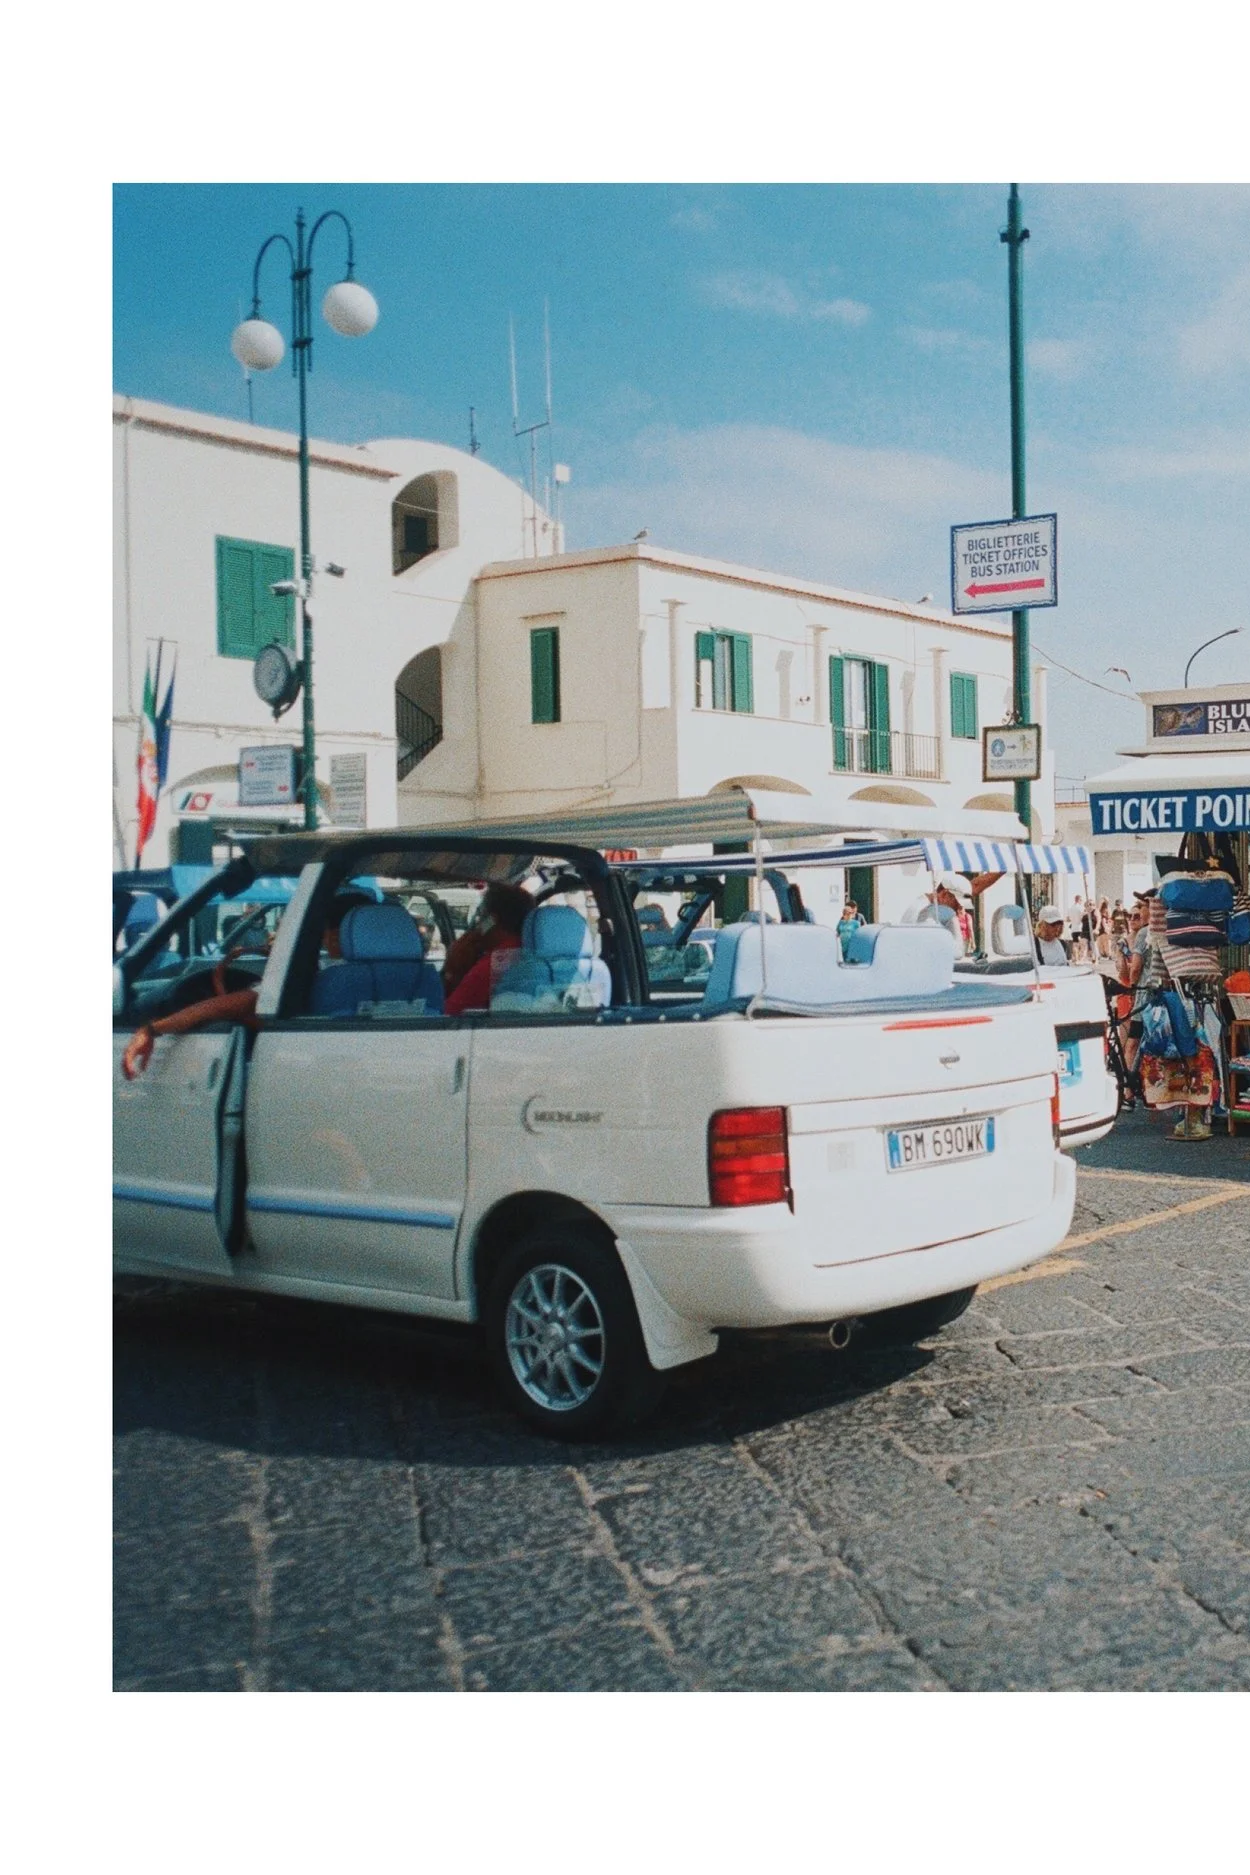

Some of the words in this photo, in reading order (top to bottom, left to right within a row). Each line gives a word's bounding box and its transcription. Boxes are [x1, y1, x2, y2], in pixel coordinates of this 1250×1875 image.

[967, 531, 1040, 551] BIGLIETTERIE
[962, 550, 1001, 565] TICKET
[1003, 545, 1048, 561] OFFICES
[971, 565, 993, 578] BUS
[995, 560, 1040, 576] STATION
[1098, 795, 1188, 831] TICKET
[902, 1131, 926, 1163] BM
